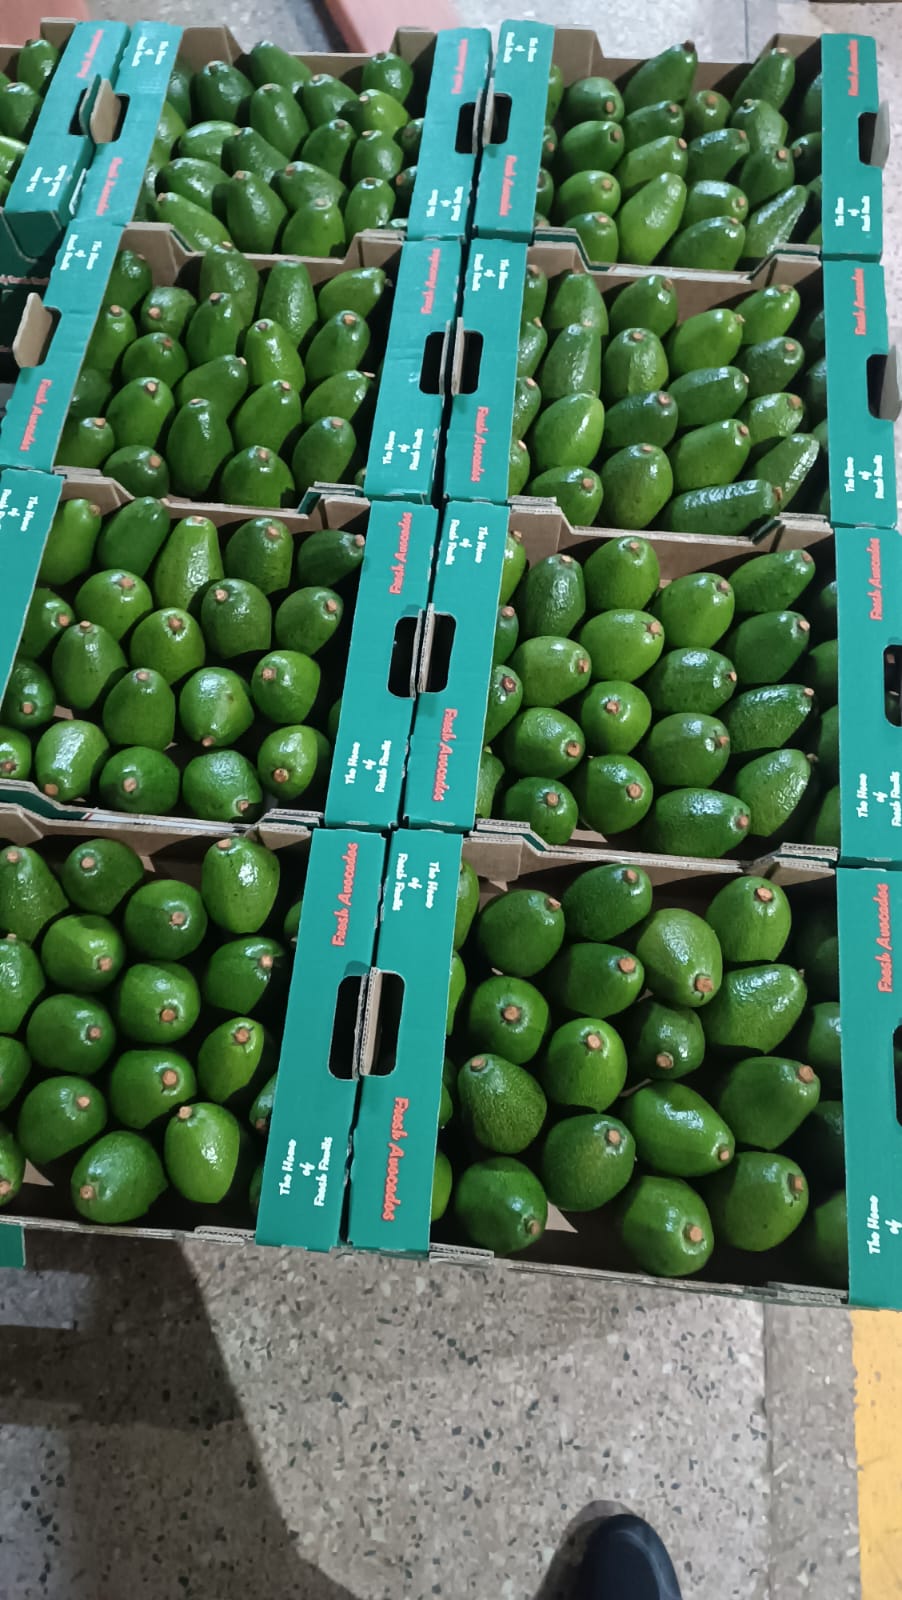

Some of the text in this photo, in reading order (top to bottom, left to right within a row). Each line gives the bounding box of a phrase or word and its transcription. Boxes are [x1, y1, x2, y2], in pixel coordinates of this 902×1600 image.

[344, 767, 357, 785] The
[362, 758, 377, 771] of
[432, 707, 459, 802] Fresh Avocados
[407, 876, 423, 890] of
[428, 861, 441, 880] The
[331, 842, 359, 947] Fresh Avocados
[872, 882, 894, 993] Fresh Avocados
[278, 1138, 297, 1196] The Home
[299, 1161, 316, 1177] of
[382, 1096, 410, 1221] Fresh Avocados
[313, 1173, 328, 1207] Fresh
[866, 1194, 881, 1255] The Home
